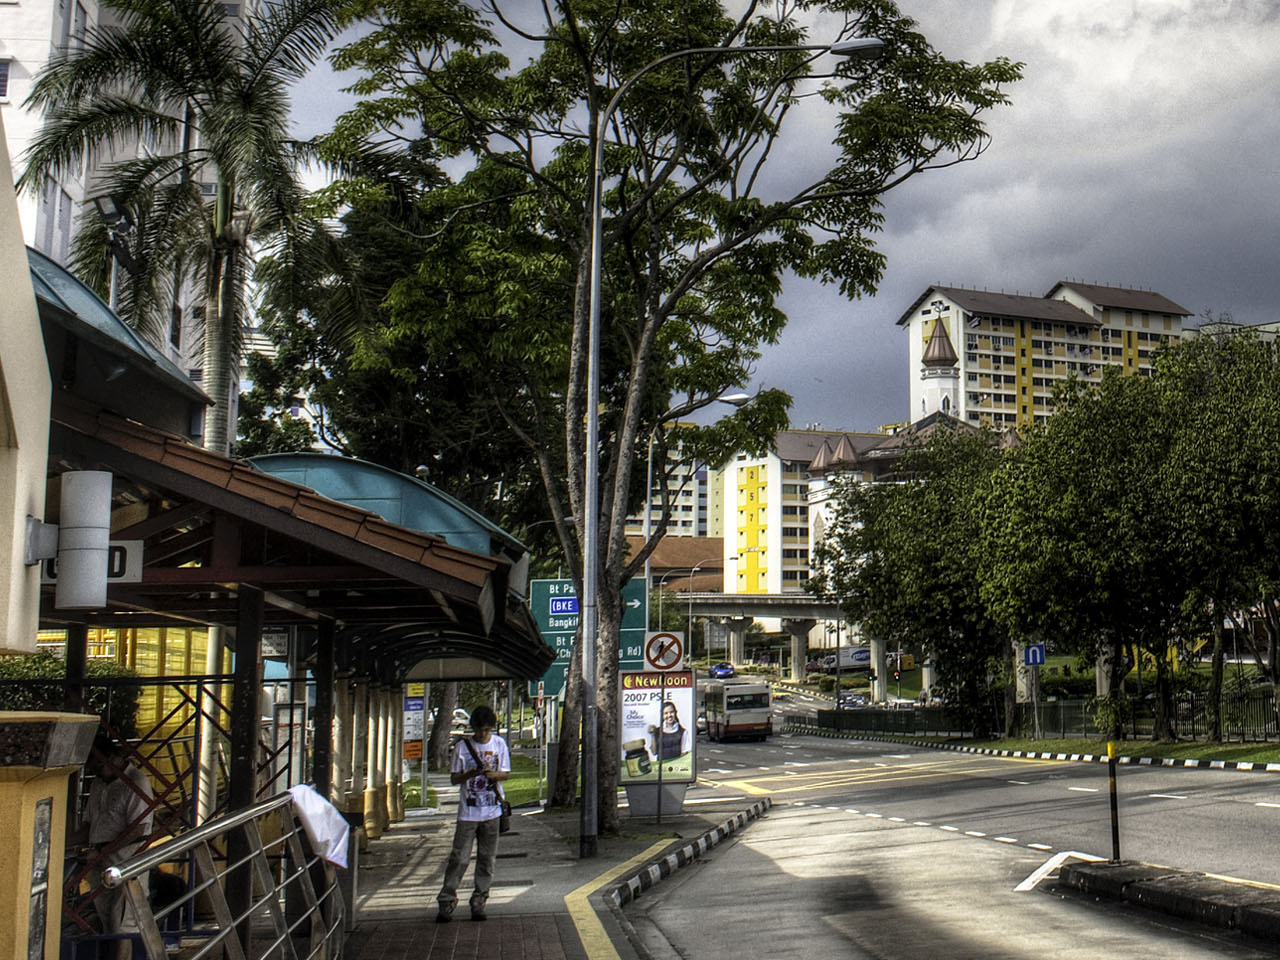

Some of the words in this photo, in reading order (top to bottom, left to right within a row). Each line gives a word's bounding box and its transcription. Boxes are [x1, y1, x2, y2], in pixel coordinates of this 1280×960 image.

[549, 584, 560, 594] Bt
[552, 600, 573, 611] (BKE
[556, 636, 566, 646] Bt
[627, 645, 642, 656] Rd)
[624, 693, 647, 702] 2007
[650, 691, 673, 701] PSE
